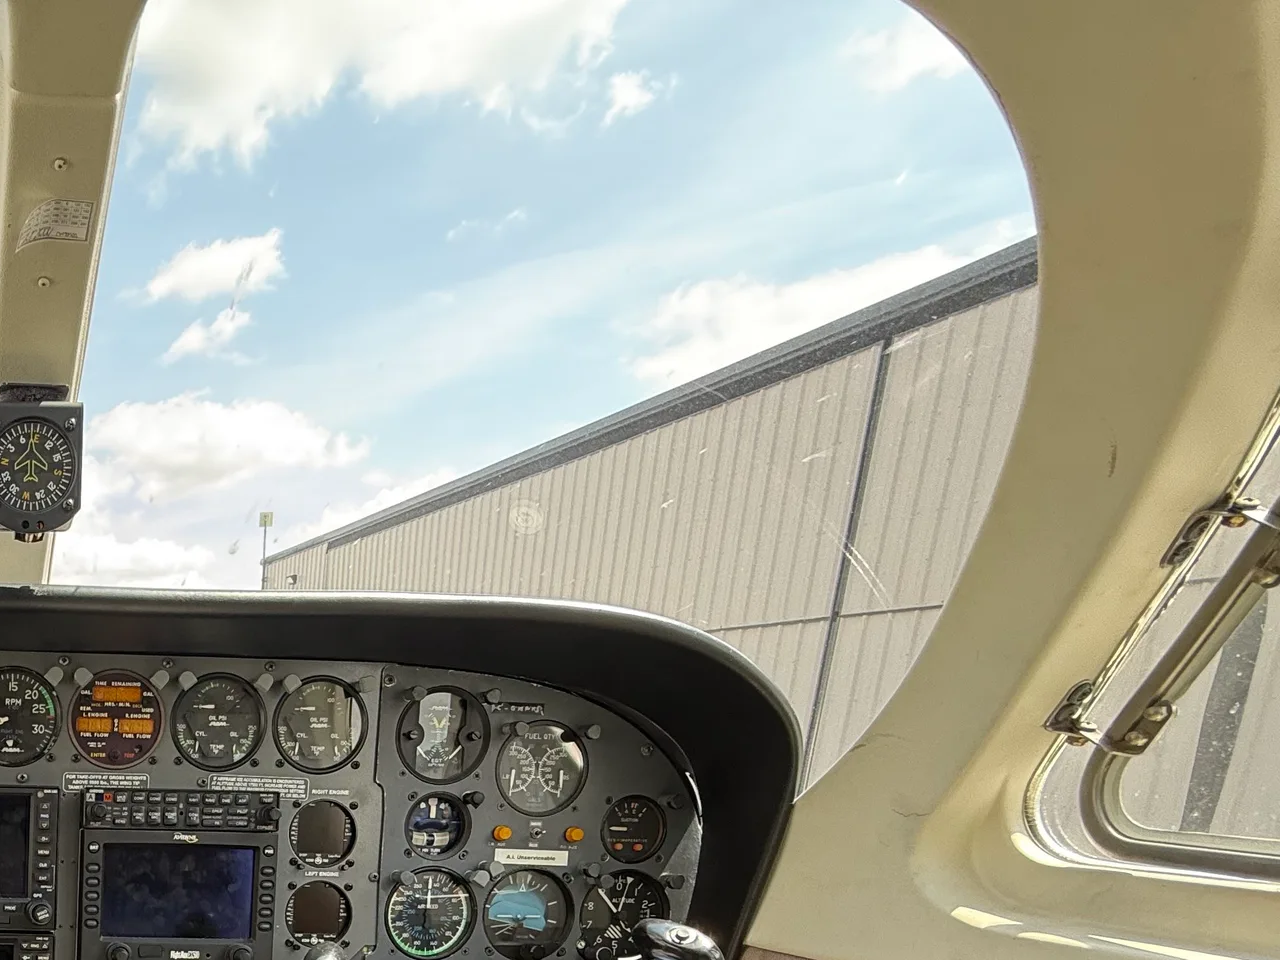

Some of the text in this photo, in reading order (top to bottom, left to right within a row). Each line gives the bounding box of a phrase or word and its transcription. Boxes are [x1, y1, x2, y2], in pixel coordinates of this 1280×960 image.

[20, 435, 26, 444] 6
[34, 434, 40, 443] E
[8, 443, 16, 453] 3
[45, 439, 55, 450] 12
[0, 457, 9, 465] N
[53, 453, 62, 463] 15
[1, 471, 11, 482] 33
[55, 468, 64, 476] S
[8, 483, 20, 495] 30
[48, 480, 57, 491] 21
[22, 491, 30, 500] W
[35, 489, 46, 500] 24
[8, 682, 18, 692] 15
[25, 690, 39, 700] 20
[5, 698, 22, 706] RPM
[32, 704, 46, 714] 25
[32, 725, 45, 734] 30
[642, 900, 648, 908] 2
